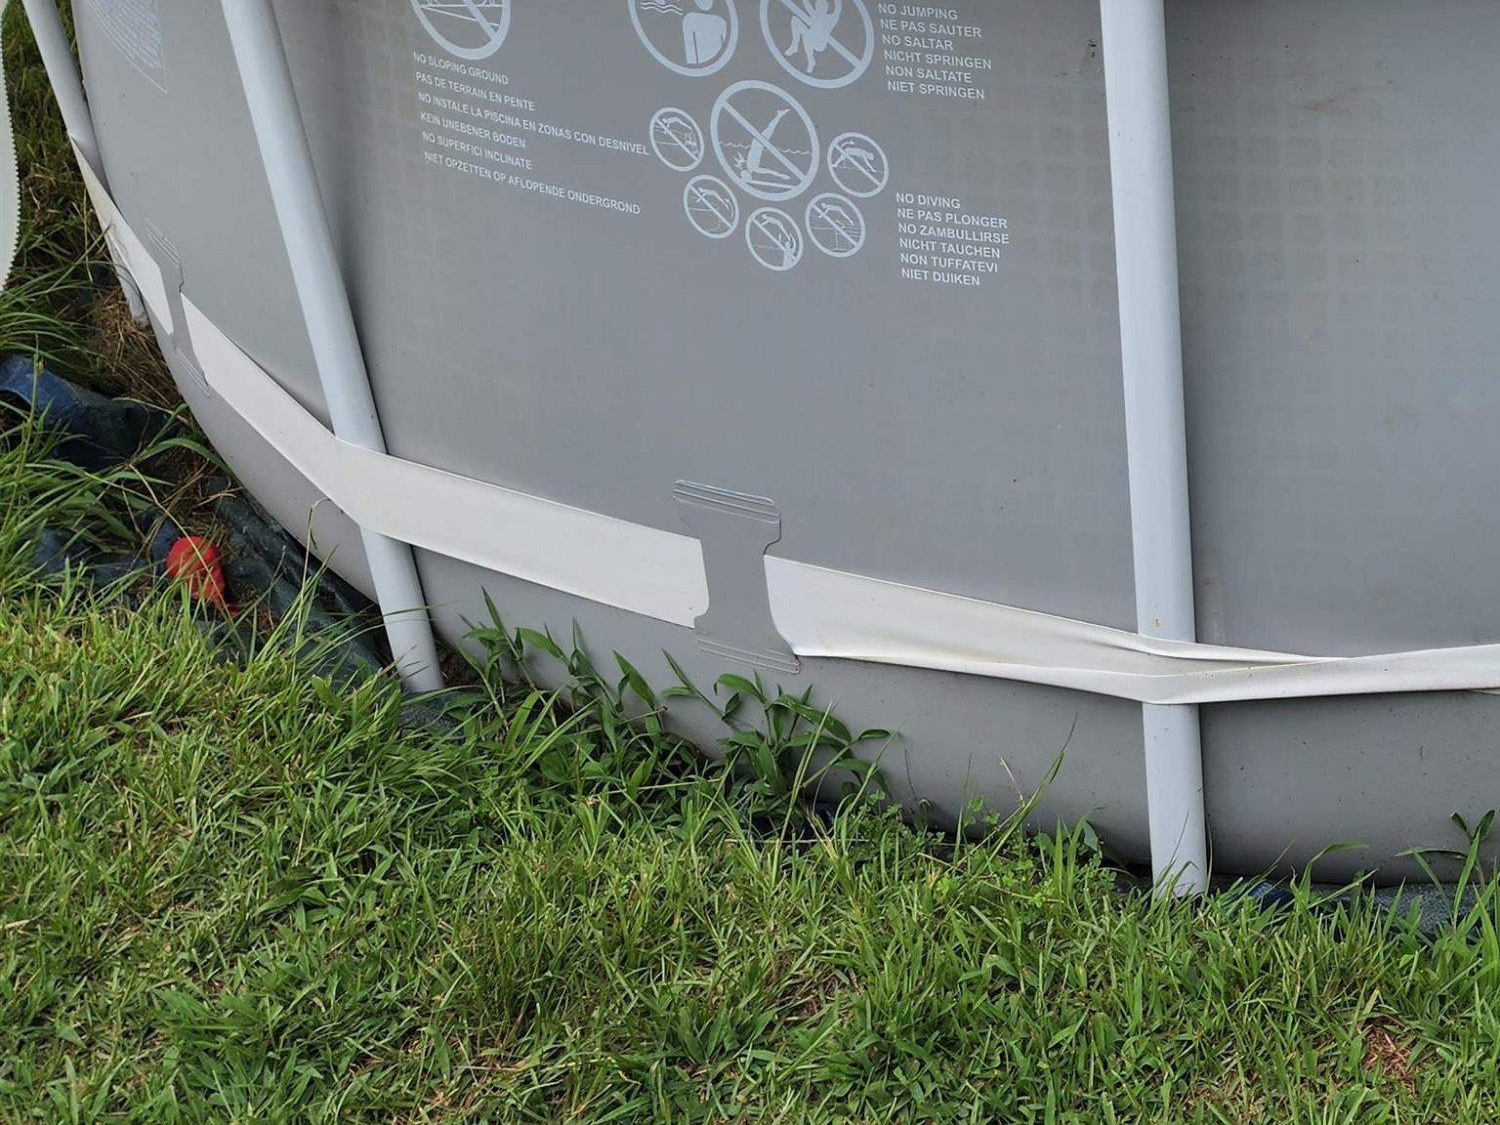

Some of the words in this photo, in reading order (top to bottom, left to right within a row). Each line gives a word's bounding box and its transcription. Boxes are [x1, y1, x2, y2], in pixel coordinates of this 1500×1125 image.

[878, 3, 897, 15] NO
[900, 5, 958, 20] JUMPING
[880, 18, 898, 30] NE
[901, 20, 926, 32] PAS
[929, 23, 982, 38] SAUTER
[882, 34, 901, 46] NO
[904, 36, 954, 51] SALTAR
[413, 52, 426, 64] NO
[427, 55, 467, 75] SLOPING
[468, 66, 509, 86] GROUND
[884, 49, 921, 63] NICHT
[925, 53, 991, 69] SPRINGEN
[885, 65, 913, 77] NON
[917, 68, 972, 83] SALTATE
[415, 71, 432, 86] PAS
[435, 76, 447, 89] DE
[449, 80, 487, 100] TERRAIN
[489, 91, 502, 102] EN
[504, 95, 536, 112] PENTE
[887, 80, 915, 93] NIET
[919, 83, 985, 100] SPRINGEN
[418, 92, 431, 104] NO
[433, 95, 469, 114] INSTALE
[471, 106, 483, 118] LA
[484, 109, 521, 127] PISCINA
[522, 119, 536, 132] EN
[538, 122, 572, 140] ZONAS
[573, 131, 596, 146] CON
[598, 136, 650, 155] DESNIVEL
[420, 111, 440, 125] KEIN
[442, 117, 491, 140] UNEBENER
[493, 131, 526, 149] BODEN
[422, 131, 435, 143] NO
[437, 135, 482, 156] SUPERFICI
[484, 149, 533, 171] INCLINATE
[424, 151, 444, 165] NIET
[445, 157, 491, 179] OPZETTEN
[493, 170, 506, 182] OP
[508, 175, 566, 198] AFLOPENDE
[567, 189, 640, 215] ONDERGROND
[896, 192, 914, 204] NO
[918, 194, 961, 209] DIVING
[897, 207, 914, 219] NE
[918, 210, 942, 222] PAS
[945, 212, 1008, 229] PLONGER
[898, 222, 916, 234] NO
[919, 225, 1010, 244] ZAMBULLIRSE
[899, 237, 937, 251] NICHT
[940, 241, 1000, 259] TAUCHEN
[900, 253, 928, 265] NON
[931, 256, 998, 273] TUFFATEVI
[901, 267, 929, 280] NIET
[932, 271, 980, 286] DUIKEN
